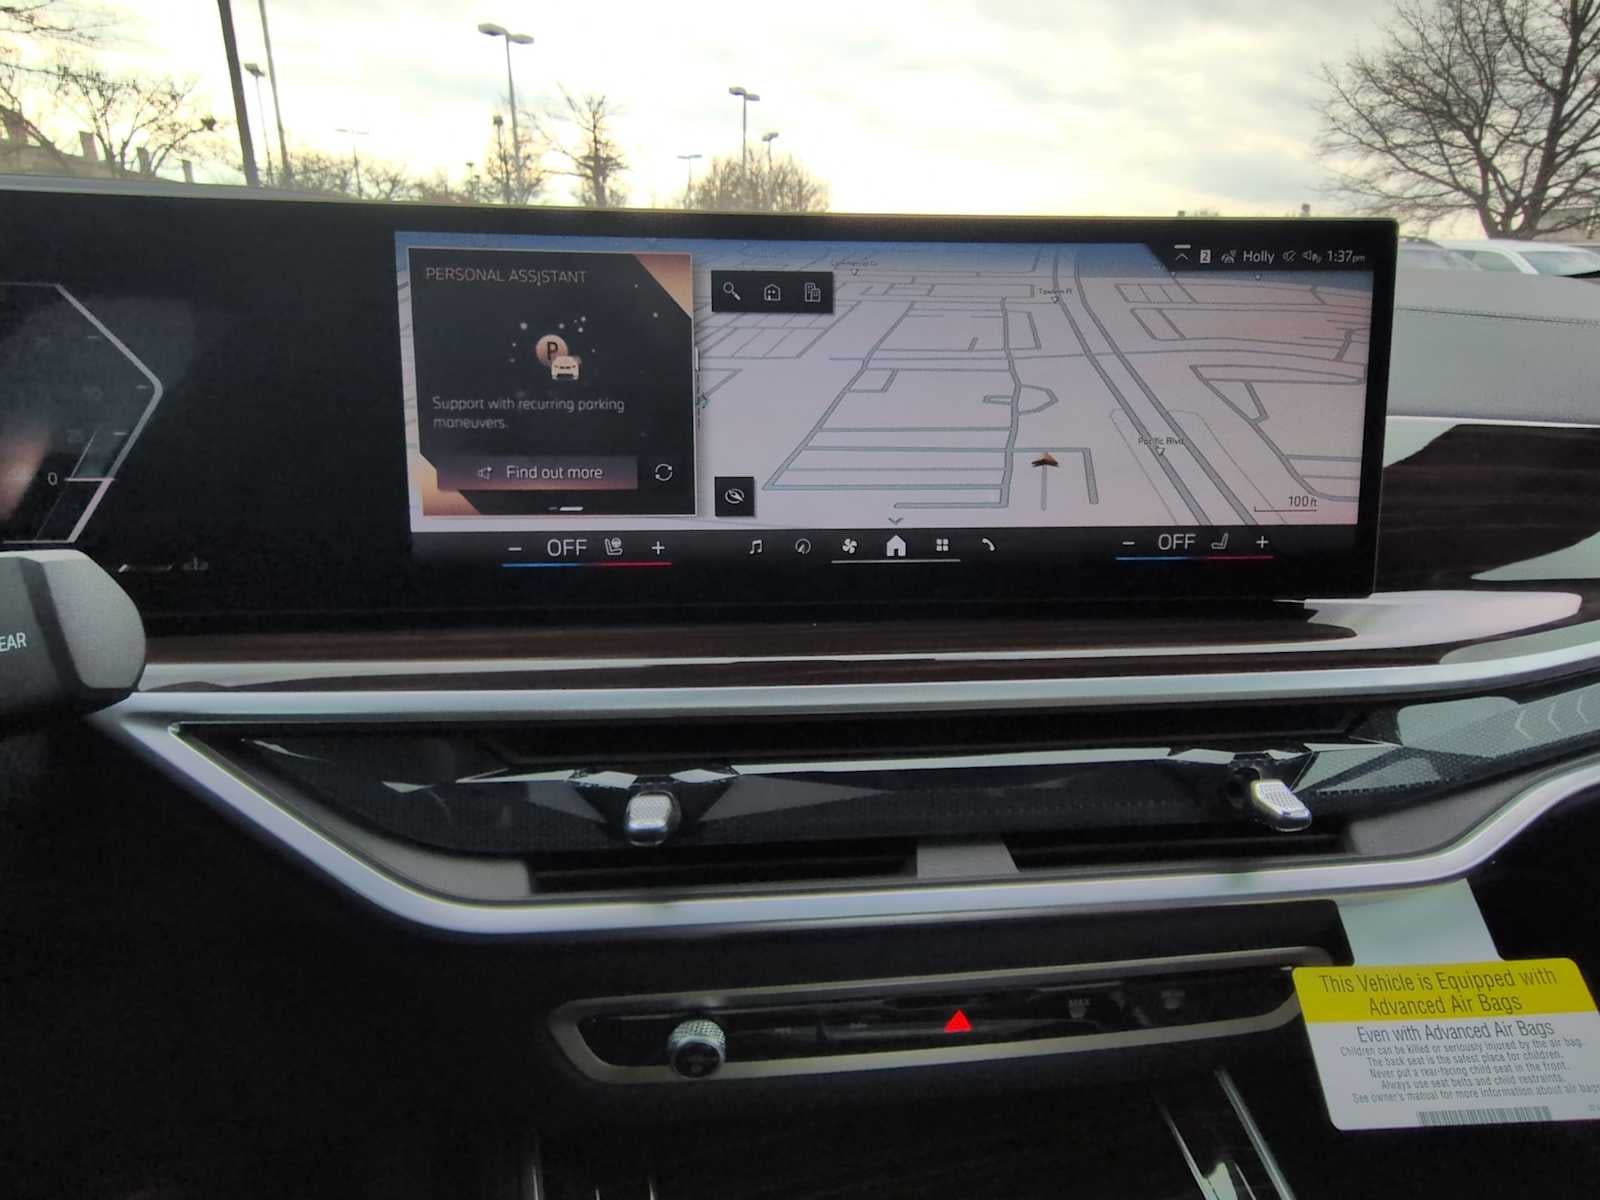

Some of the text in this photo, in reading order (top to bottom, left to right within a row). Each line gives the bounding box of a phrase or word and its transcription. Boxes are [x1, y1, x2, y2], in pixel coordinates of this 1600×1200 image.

[1243, 250, 1275, 264] Holly
[426, 267, 587, 283] PERSONAL ASSISTANT
[547, 341, 558, 360] P
[432, 396, 625, 413] Support with recurring parking
[433, 417, 508, 429] maneuvers.
[506, 465, 603, 479] Find out more
[547, 538, 588, 557] OFF
[1158, 533, 1196, 550] OFF
[1318, 967, 1558, 993] This Vehicle is Equipped with
[1369, 993, 1523, 1016] Advanced Air Bags
[1356, 1020, 1555, 1042] Even with Advanced Air Bags
[1340, 1046, 1376, 1057] Children
[1377, 1046, 1393, 1056] can
[1394, 1045, 1406, 1055] be
[1407, 1044, 1431, 1054] killed
[1432, 1045, 1443, 1053] or
[1444, 1042, 1483, 1054] seriously
[1486, 1040, 1516, 1052] injured
[1518, 1040, 1530, 1050] by
[1532, 1038, 1548, 1049] the
[1550, 1038, 1561, 1048] air
[1366, 1057, 1383, 1067] The
[1384, 1056, 1405, 1066] back
[1407, 1055, 1425, 1066] seat
[1427, 1055, 1436, 1064] is
[1436, 1053, 1452, 1064] the
[1452, 1052, 1480, 1063] safest
[1481, 1051, 1506, 1063] place
[1506, 1050, 1520, 1061] for
[1369, 1067, 1394, 1079] Never
[1396, 1066, 1413, 1079] put
[1420, 1064, 1467, 1078] rear-facing
[1468, 1063, 1492, 1074] child
[1494, 1063, 1513, 1074] seat
[1515, 1063, 1524, 1073] in
[1525, 1061, 1541, 1072] the
[1381, 1080, 1411, 1092] Always
[1412, 1080, 1429, 1090] use
[1430, 1079, 1449, 1089] seat
[1451, 1077, 1473, 1088] belts
[1475, 1076, 1493, 1086] and
[1494, 1075, 1517, 1086] child
[1352, 1092, 1370, 1104] See
[1371, 1092, 1405, 1103] owner's
[1406, 1089, 1440, 1102] manual
[1440, 1088, 1454, 1100] for
[1455, 1088, 1480, 1099] more
[1480, 1085, 1534, 1098] information
[1535, 1084, 1562, 1096] about
[1563, 1083, 1577, 1093] air
